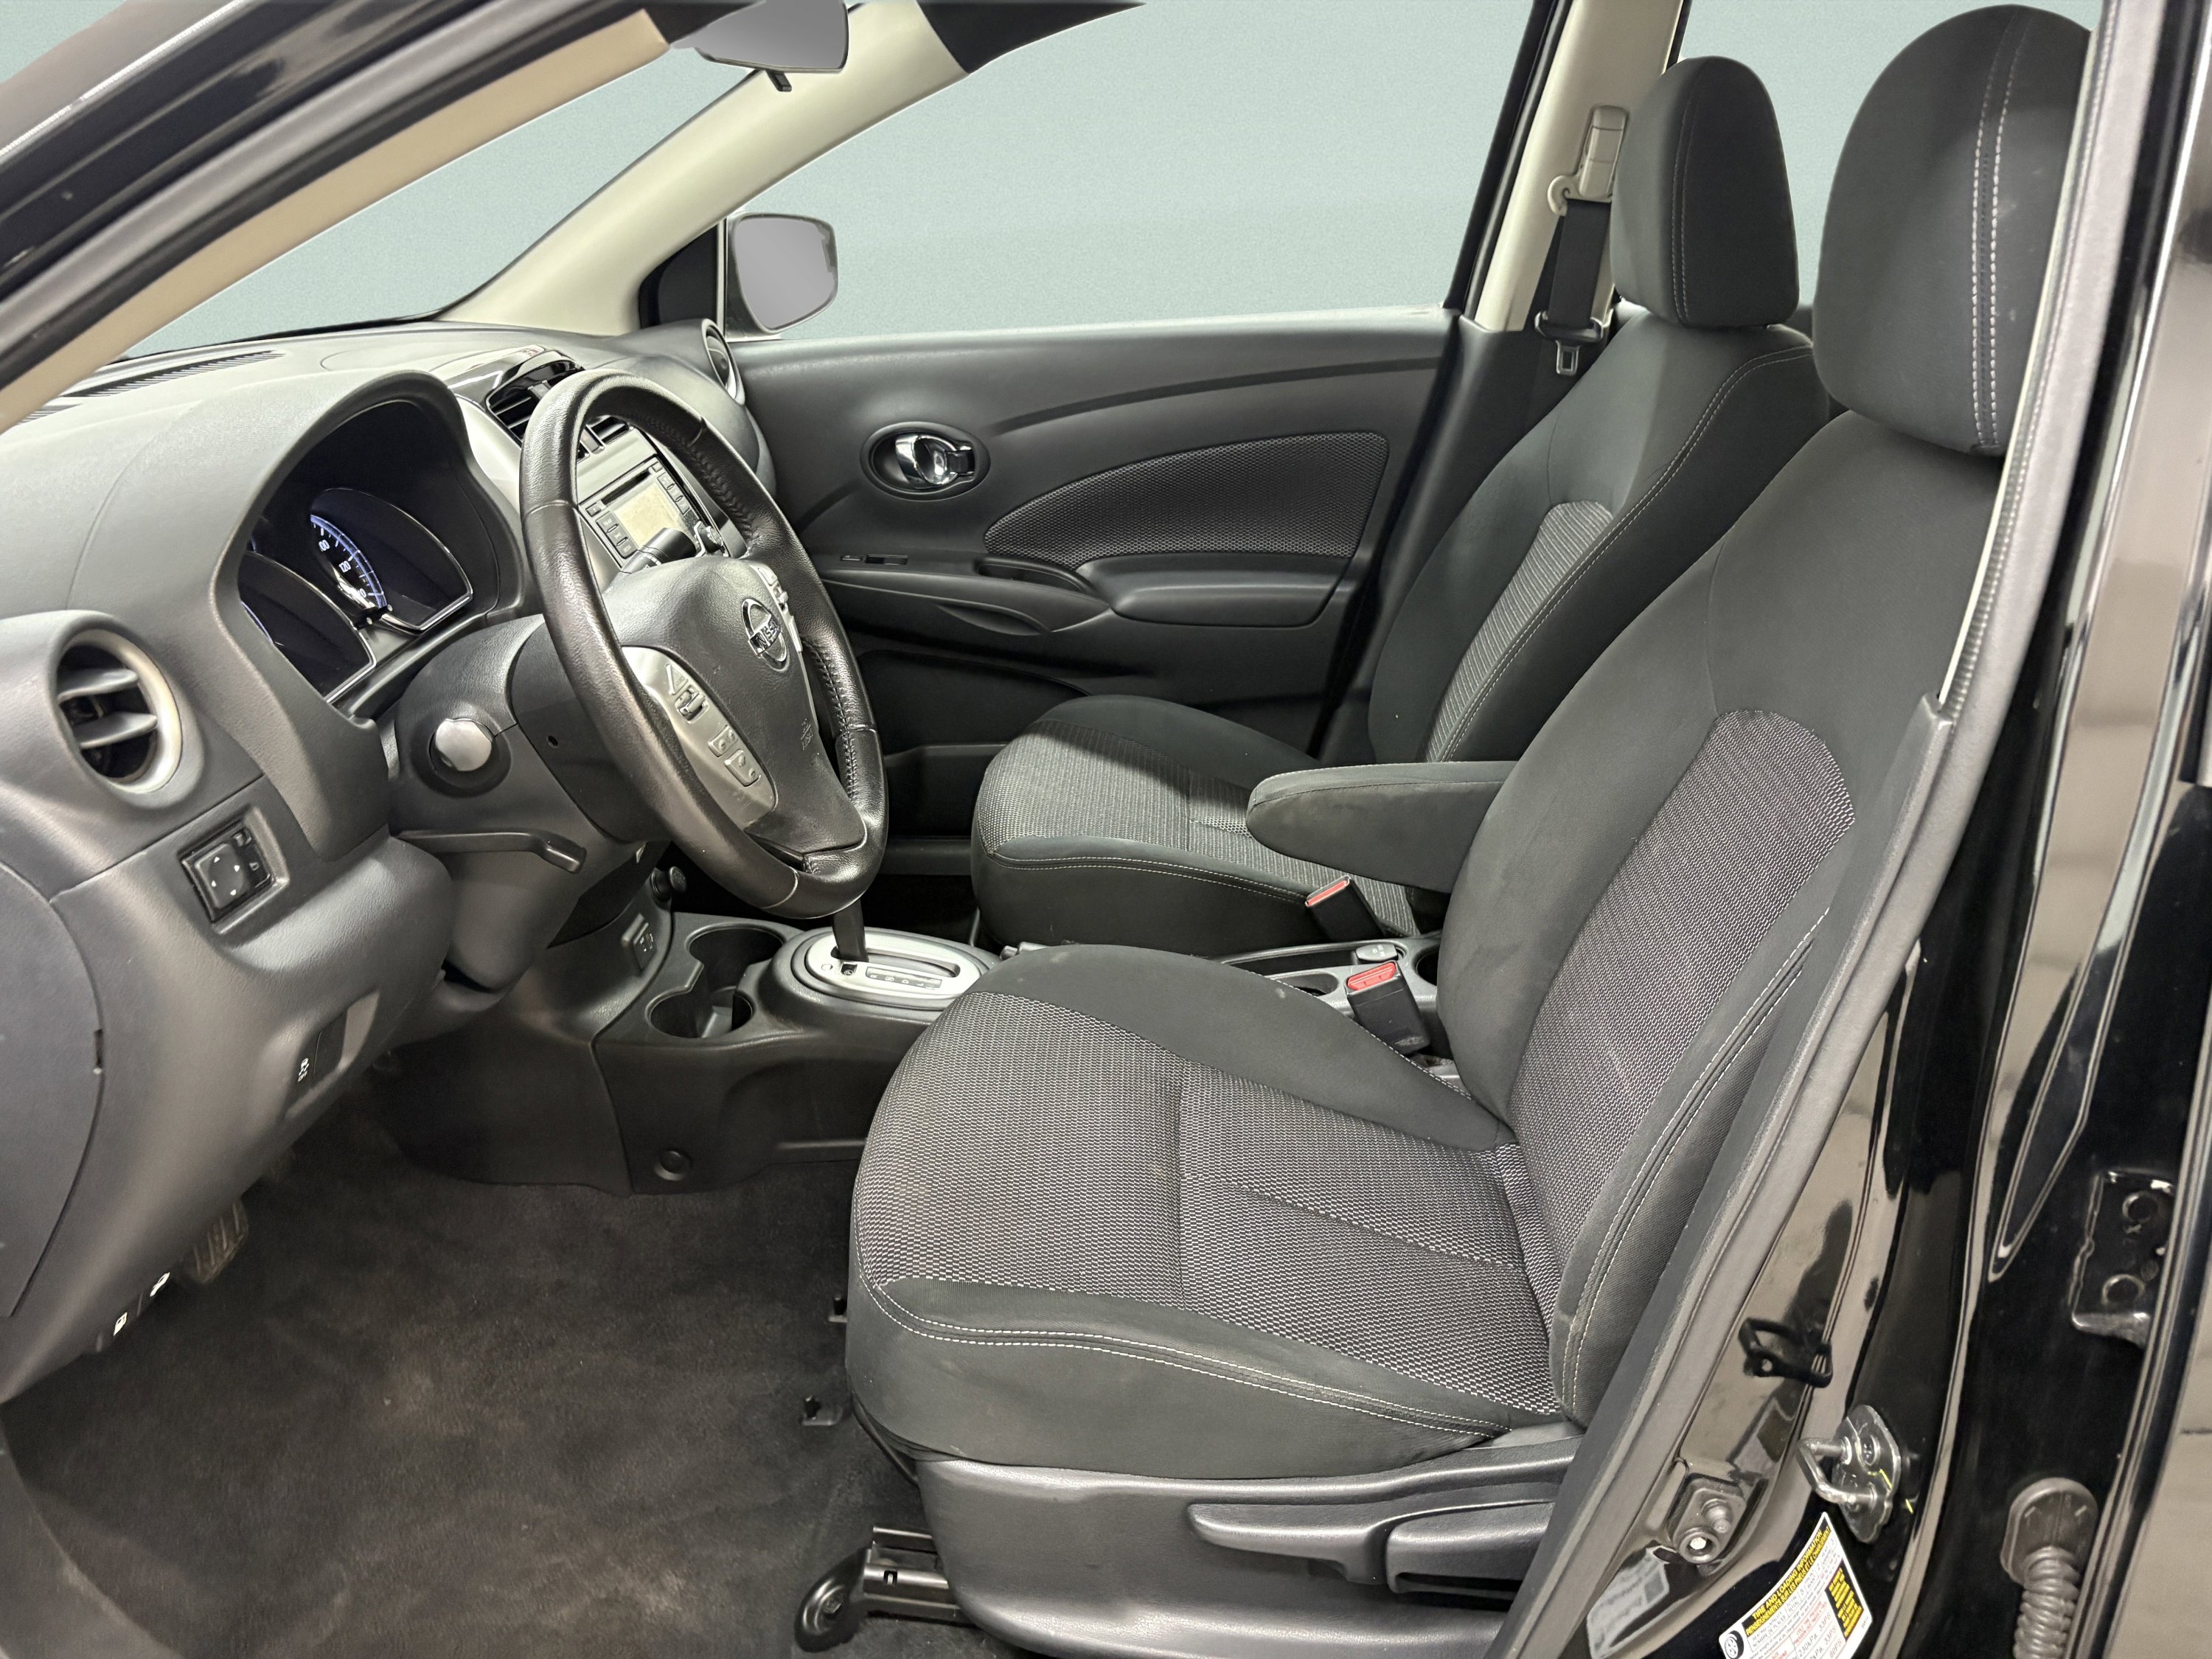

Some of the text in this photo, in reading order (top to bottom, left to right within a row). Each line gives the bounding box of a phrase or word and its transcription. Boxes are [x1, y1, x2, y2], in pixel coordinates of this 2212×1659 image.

[319, 539, 330, 552] 00
[338, 560, 352, 573] 120
[1751, 1604, 1767, 1621] TIRE
[1765, 1593, 1778, 1610] AND
[1775, 1569, 1798, 1597] LOADING
[1796, 1528, 1823, 1572] INFORMATION
